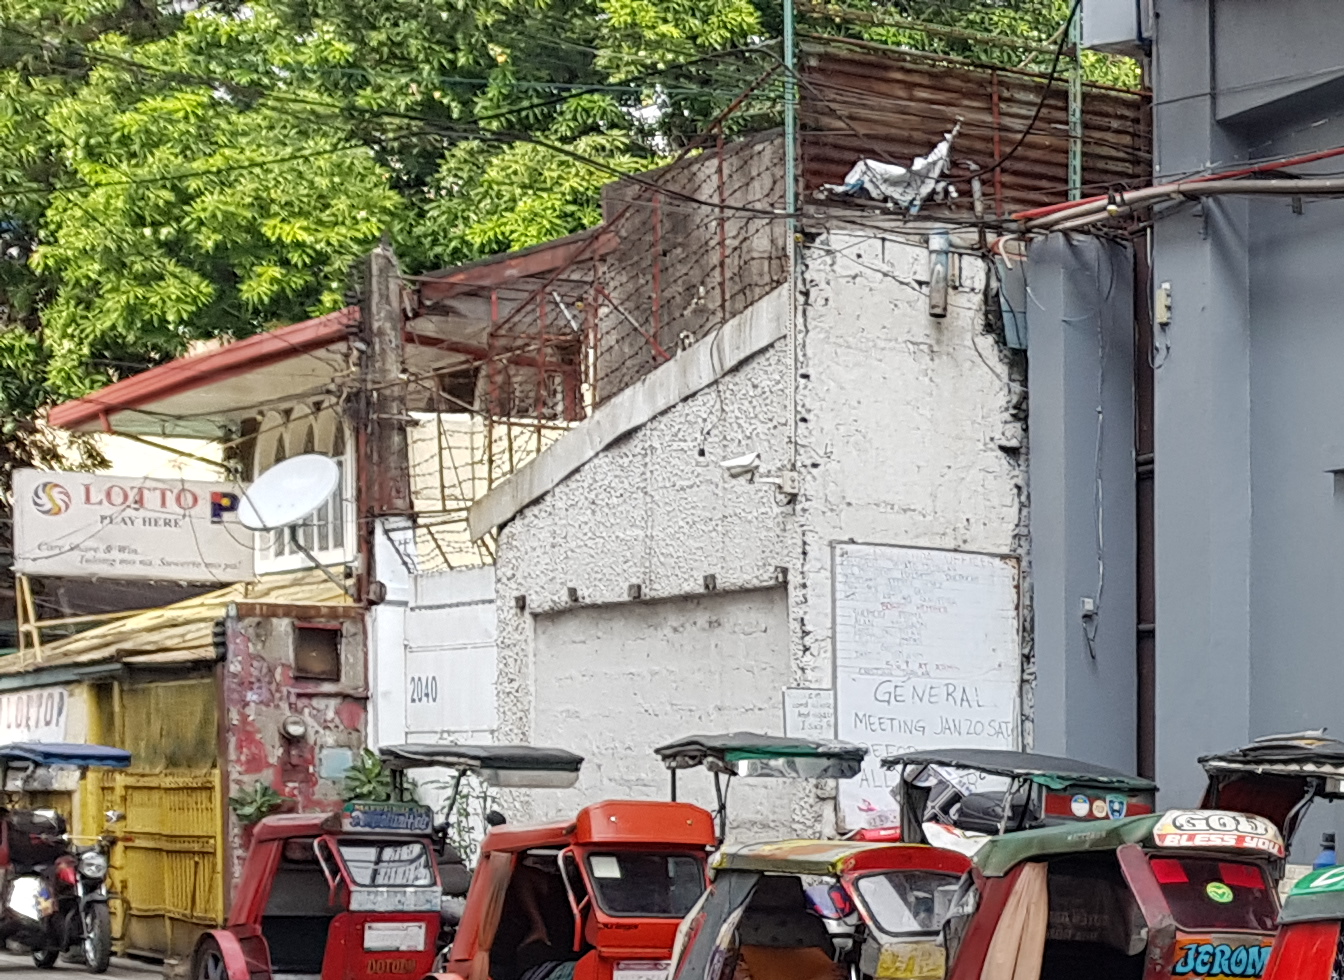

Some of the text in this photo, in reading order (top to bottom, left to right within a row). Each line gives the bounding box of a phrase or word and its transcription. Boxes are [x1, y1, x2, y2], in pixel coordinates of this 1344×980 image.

[81, 483, 199, 511] LOTTO
[99, 514, 182, 529] PLAY HERE
[410, 675, 438, 704] 2040
[874, 680, 985, 708] GENERAL
[854, 712, 926, 736] MEETING
[934, 716, 962, 736] JAN
[964, 718, 985, 736] 20
[1172, 813, 1269, 836] GOD
[1164, 834, 1280, 854] BLESS YOU
[1174, 943, 1273, 977] JEROM
